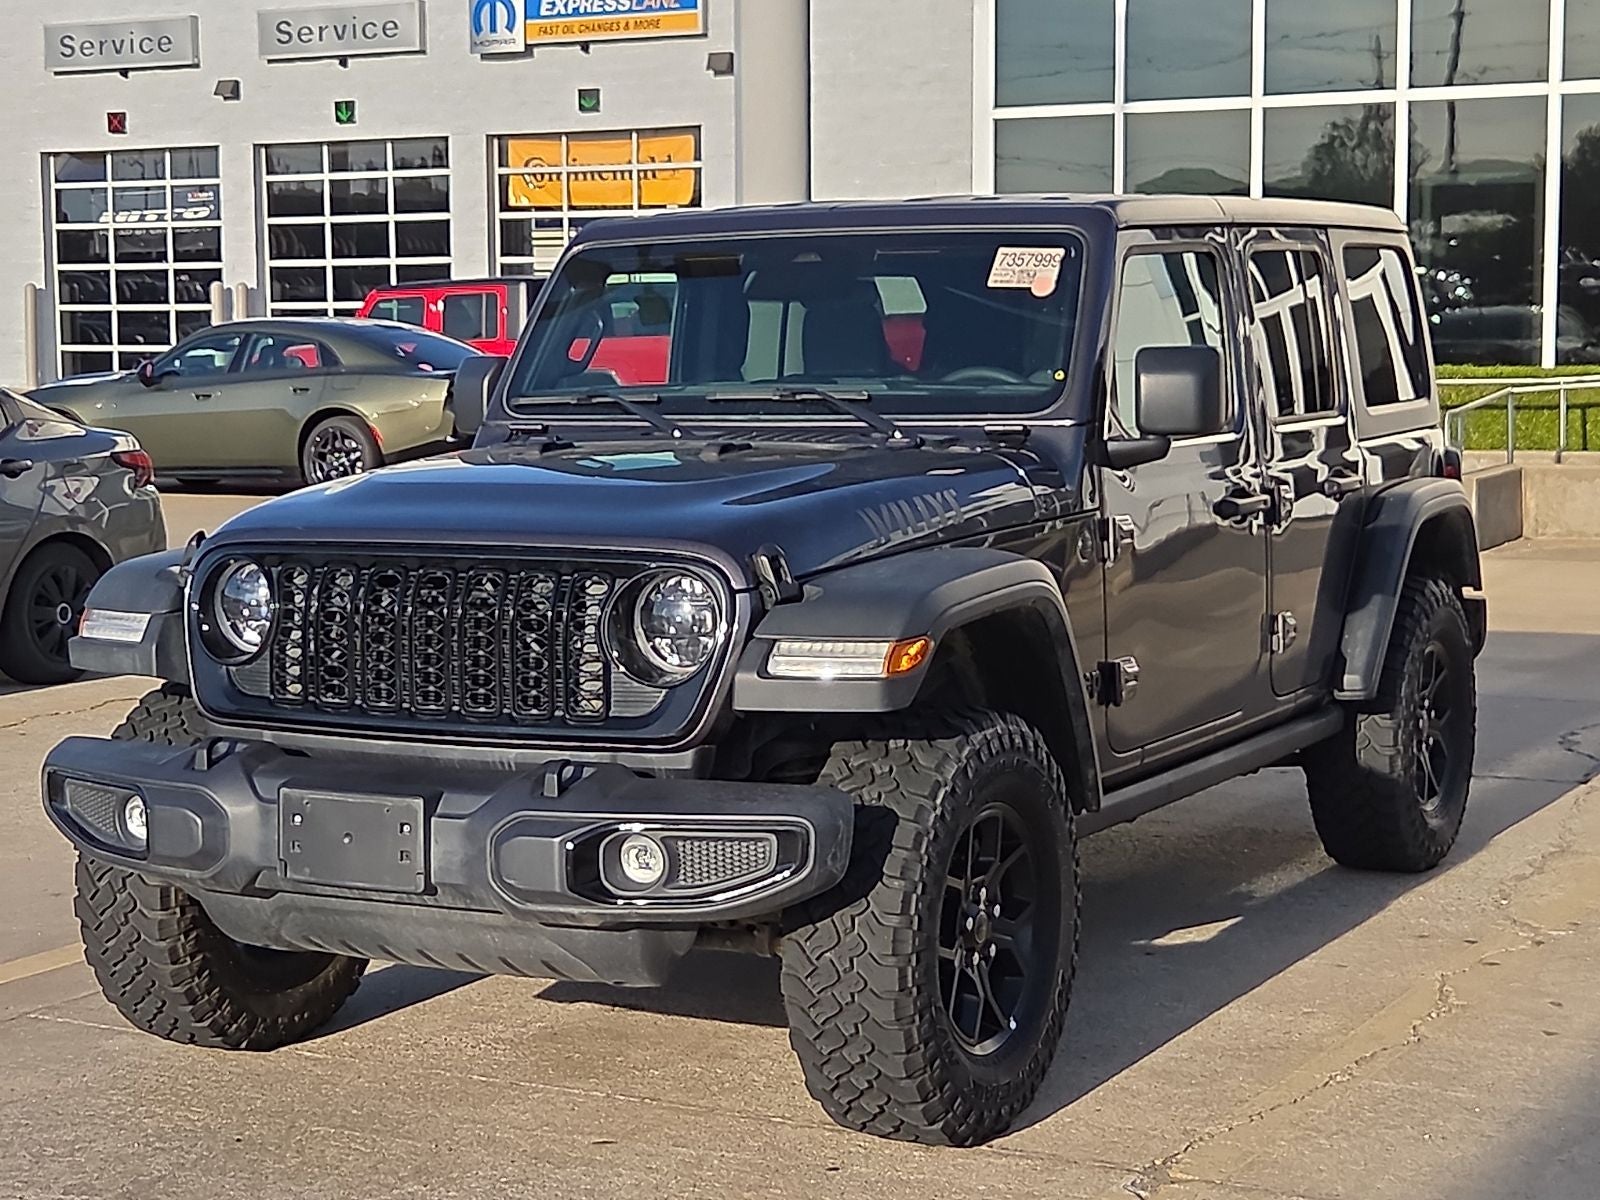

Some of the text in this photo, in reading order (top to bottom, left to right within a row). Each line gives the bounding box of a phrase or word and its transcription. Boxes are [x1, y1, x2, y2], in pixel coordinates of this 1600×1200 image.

[274, 15, 401, 45] Service
[538, 18, 661, 36] FAST OIL CHANGES & MORE
[58, 29, 175, 59] Service
[473, 38, 516, 47] MOPAR
[523, 155, 658, 189] Coninental
[998, 252, 1061, 268] 7357999
[857, 488, 964, 545] WILLYS
